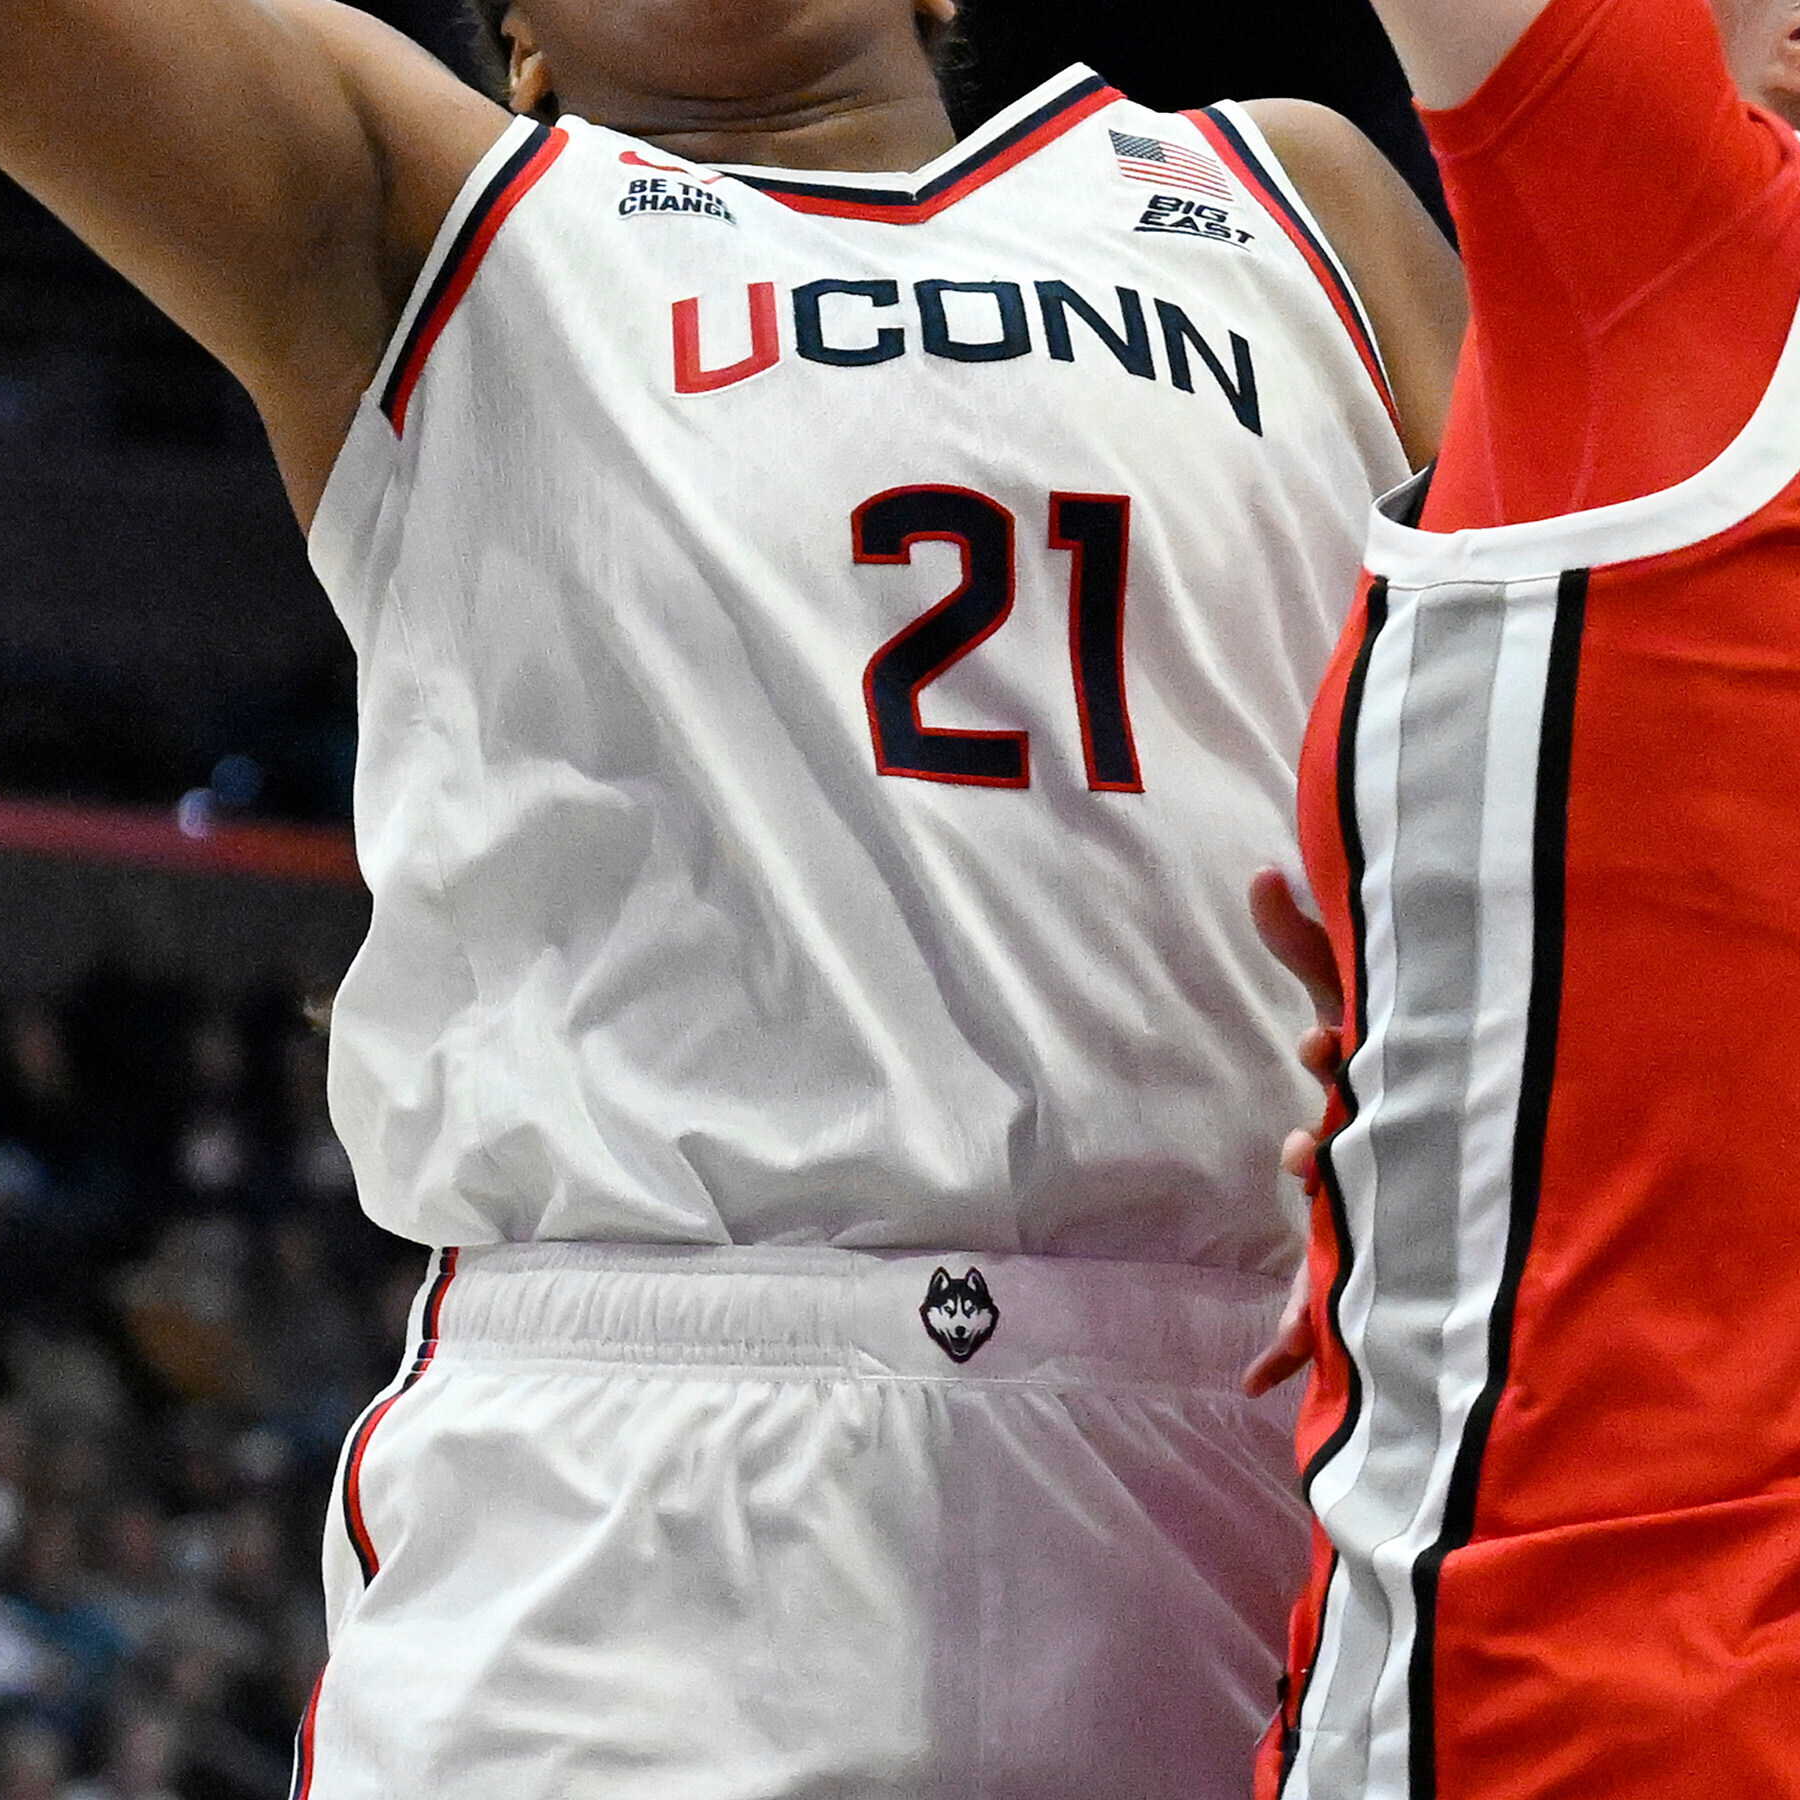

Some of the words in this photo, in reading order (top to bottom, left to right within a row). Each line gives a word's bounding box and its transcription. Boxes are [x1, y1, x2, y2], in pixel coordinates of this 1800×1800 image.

[628, 178, 668, 195] BE
[618, 194, 738, 226] CHANGE
[1147, 194, 1230, 223] BIG
[1138, 210, 1256, 244] EAST
[670, 278, 1264, 438] UCONN
[850, 482, 1145, 795] 21
